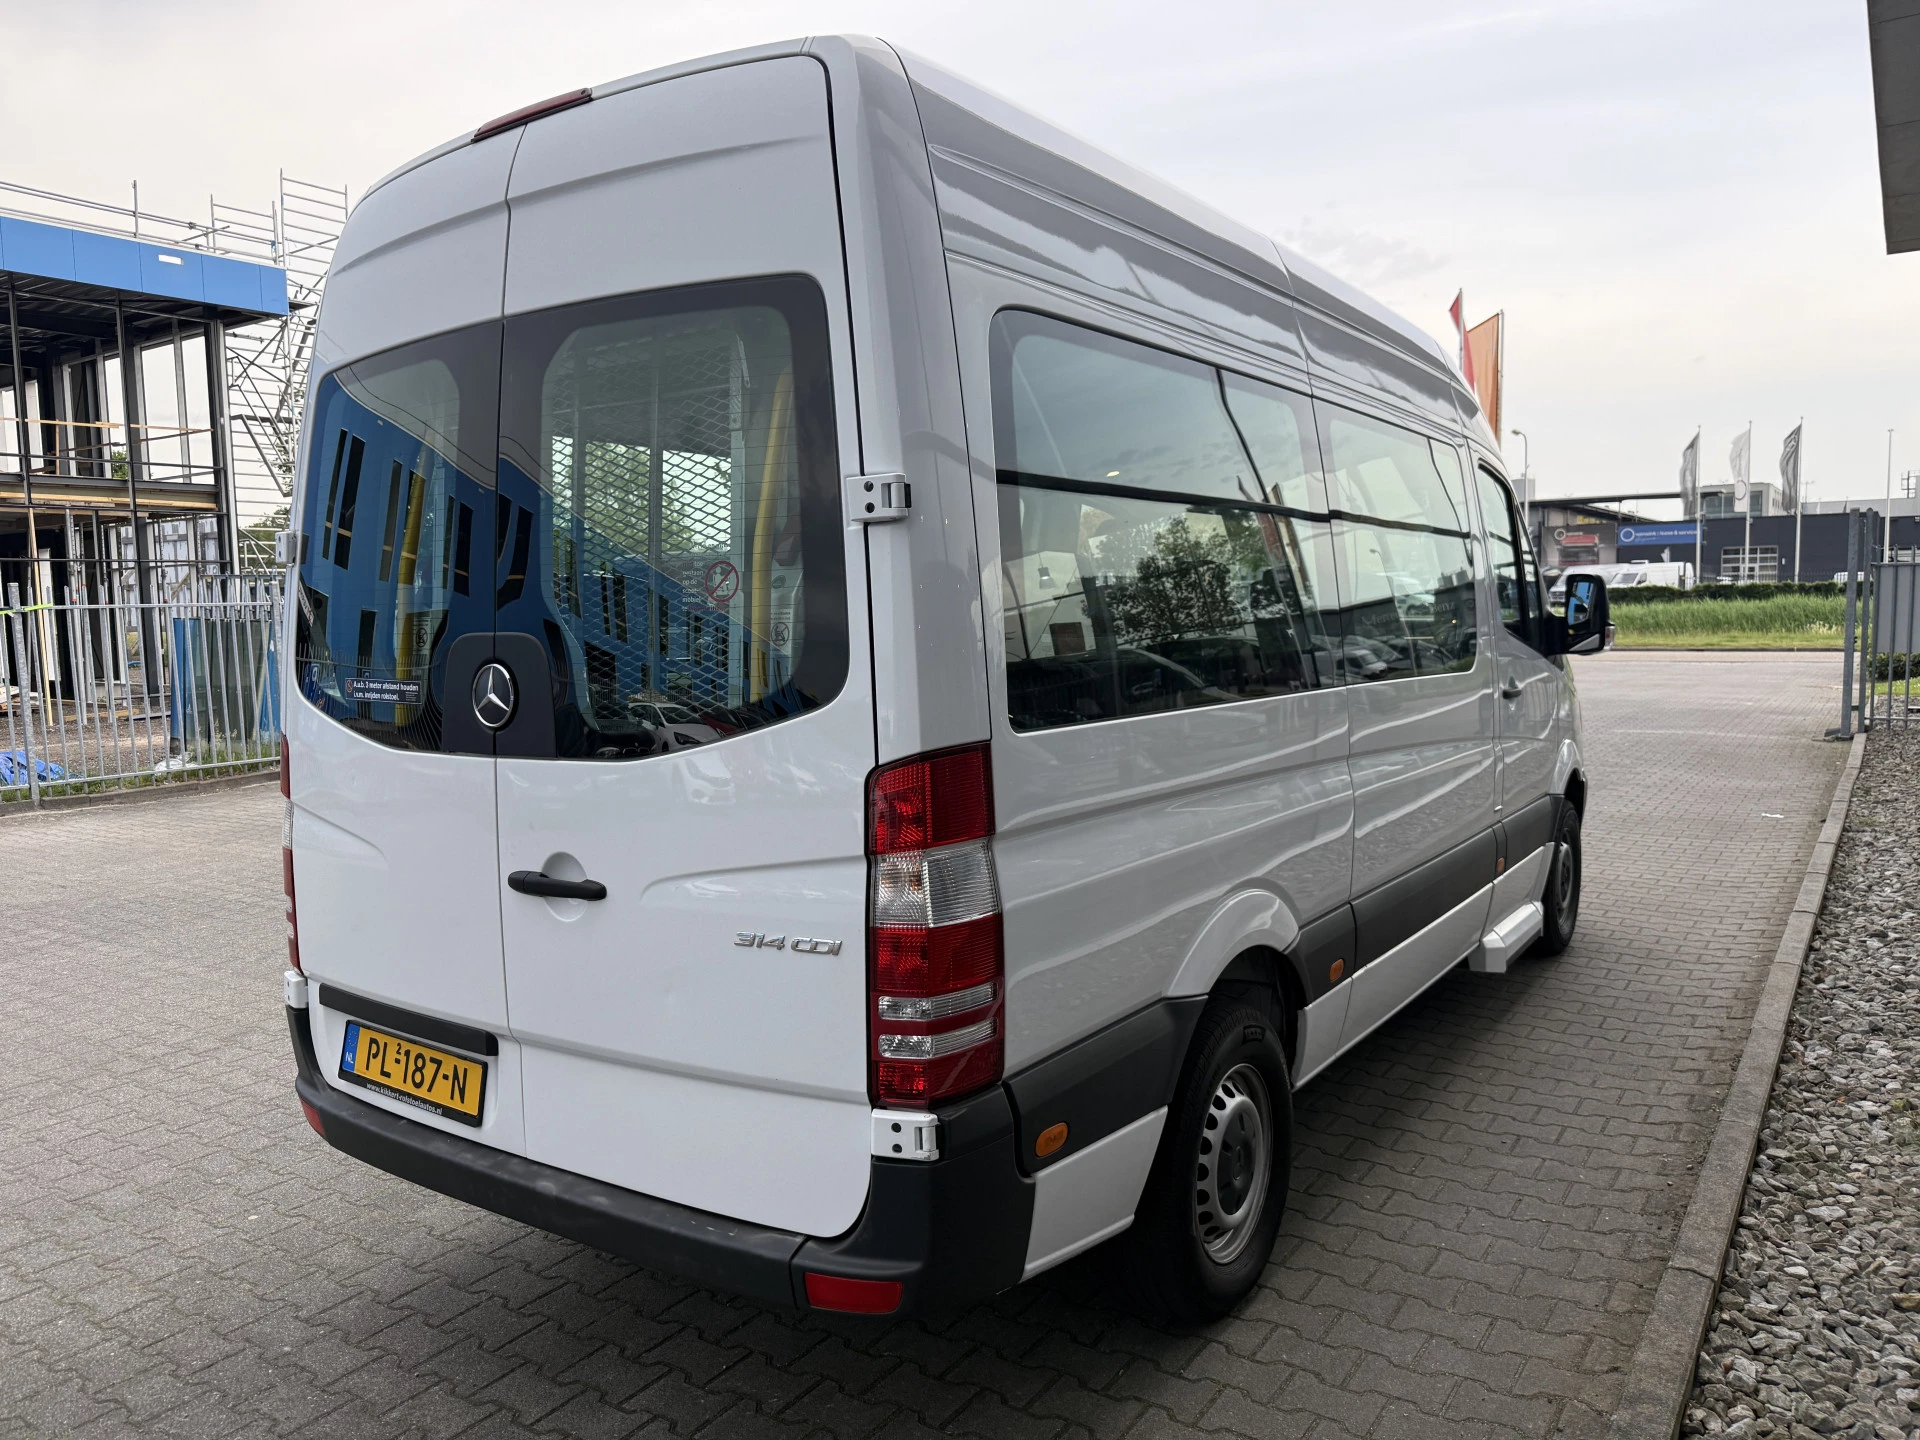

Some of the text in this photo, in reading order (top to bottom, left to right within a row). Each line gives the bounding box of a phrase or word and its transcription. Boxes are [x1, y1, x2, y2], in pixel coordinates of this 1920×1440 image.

[400, 683, 419, 691] houden
[733, 931, 843, 956] 314 CDI
[345, 1051, 354, 1064] NL
[366, 1083, 443, 1115] www.kikkert-rolstoelautos.nl
